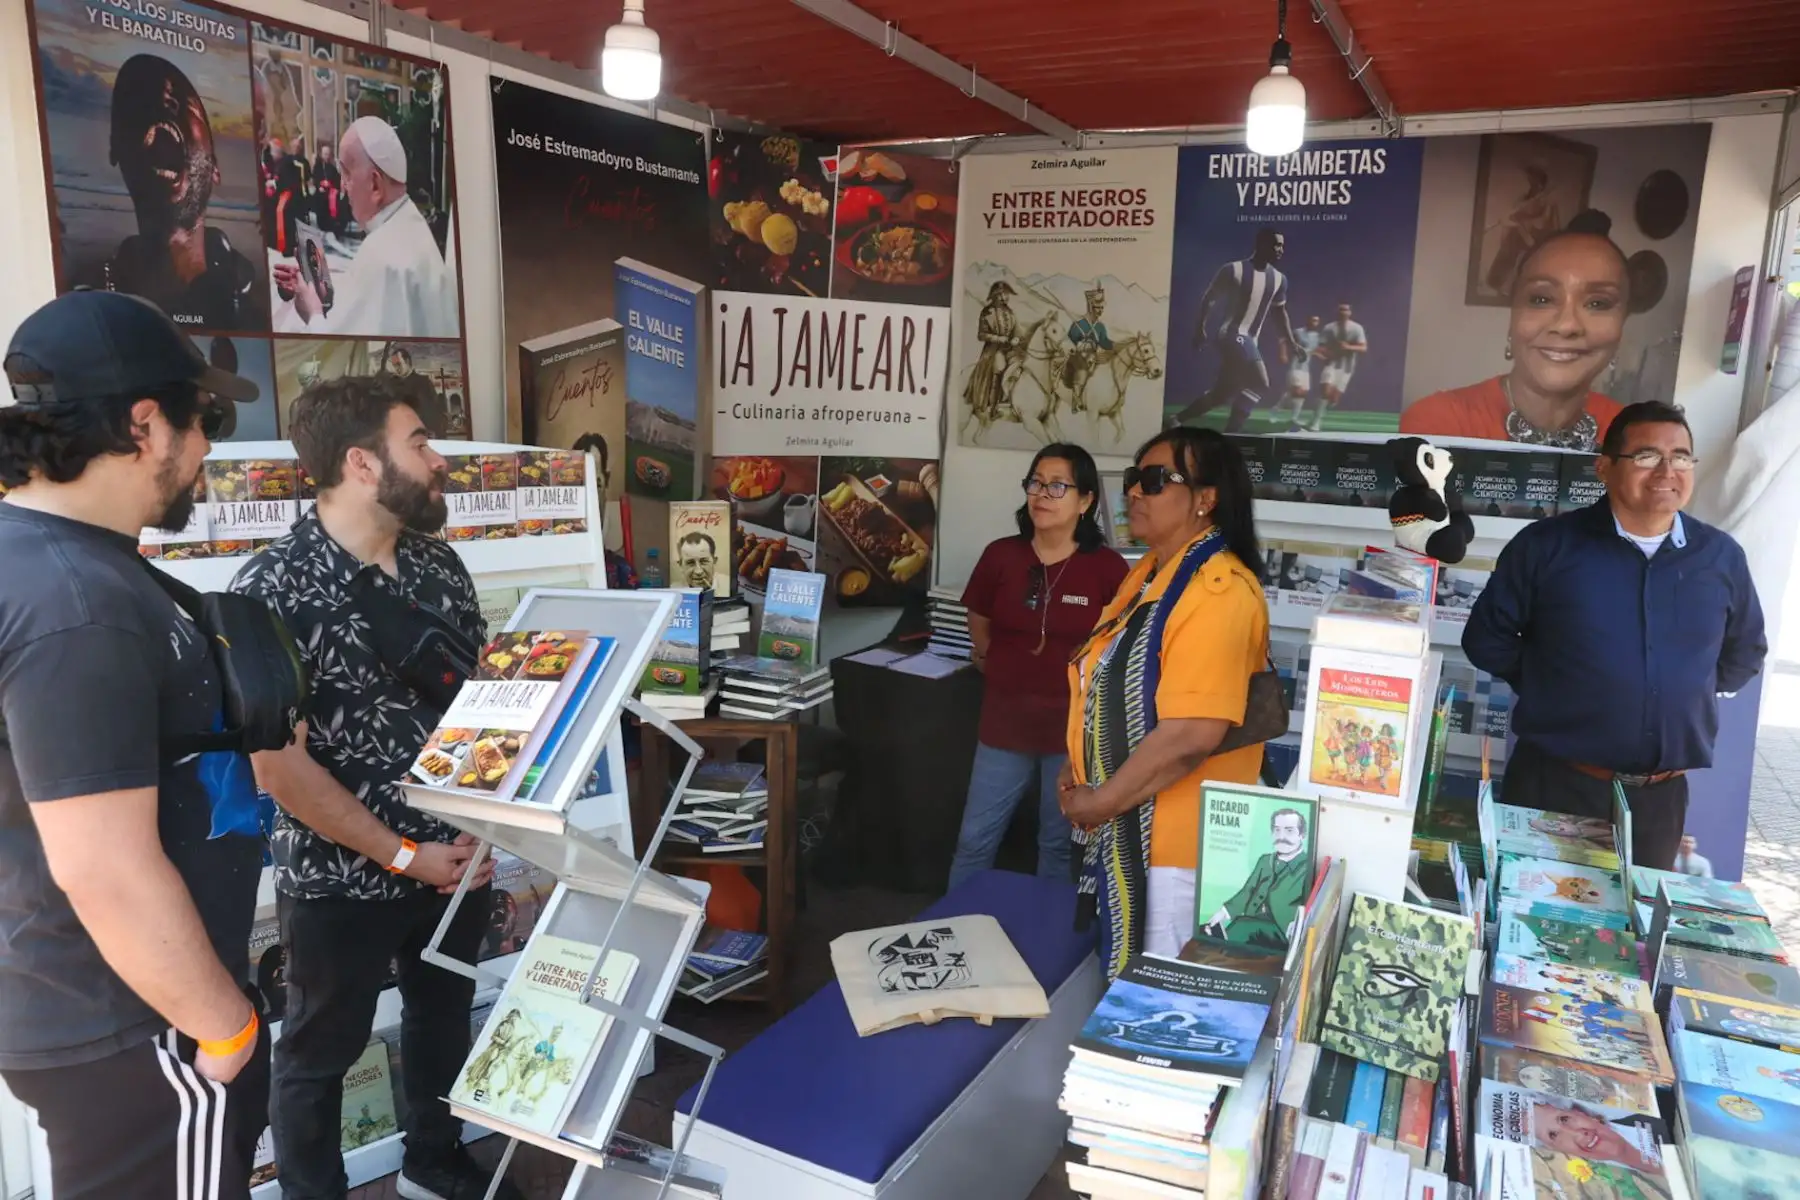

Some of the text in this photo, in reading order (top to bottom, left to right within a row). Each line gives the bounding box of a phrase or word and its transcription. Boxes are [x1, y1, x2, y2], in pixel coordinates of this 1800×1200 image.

[86, 6, 205, 53] Y EL BARATILLO
[170, 11, 235, 40] JESUITAS
[507, 128, 700, 184] José Estremadoyro Bustamante
[1031, 157, 1107, 170] Zelmira Aguilar
[1208, 148, 1387, 179] ENTRE GAMBETAS
[992, 188, 1147, 209] ENTRE NEGROS
[1236, 180, 1352, 207] Y PASIONES
[983, 209, 1155, 229] Y LIBERTADORES
[628, 309, 683, 344] EL VALLE
[627, 334, 684, 368] CALIENTE
[720, 303, 933, 396] ¡A JAMEAR!
[547, 358, 615, 421] Cuentos
[732, 403, 911, 425] Culinaria afroperuana
[469, 491, 511, 513] JAMEAR!
[537, 487, 578, 508] JAMEAR!
[232, 501, 285, 526] JAMEAR!
[676, 510, 722, 529] Cuentos
[770, 592, 815, 607] CALIENTE
[773, 582, 816, 596] EL VALLE
[1210, 799, 1249, 815] RICARDO
[1209, 813, 1240, 828] PALMA
[525, 970, 607, 998] Y LIBERTADES
[534, 960, 608, 987] ENTRE NEGOS
[345, 1064, 380, 1083] NEGROS
[1492, 1092, 1504, 1141] ECONOMIA
[1508, 1091, 1522, 1132] CARICIAS
